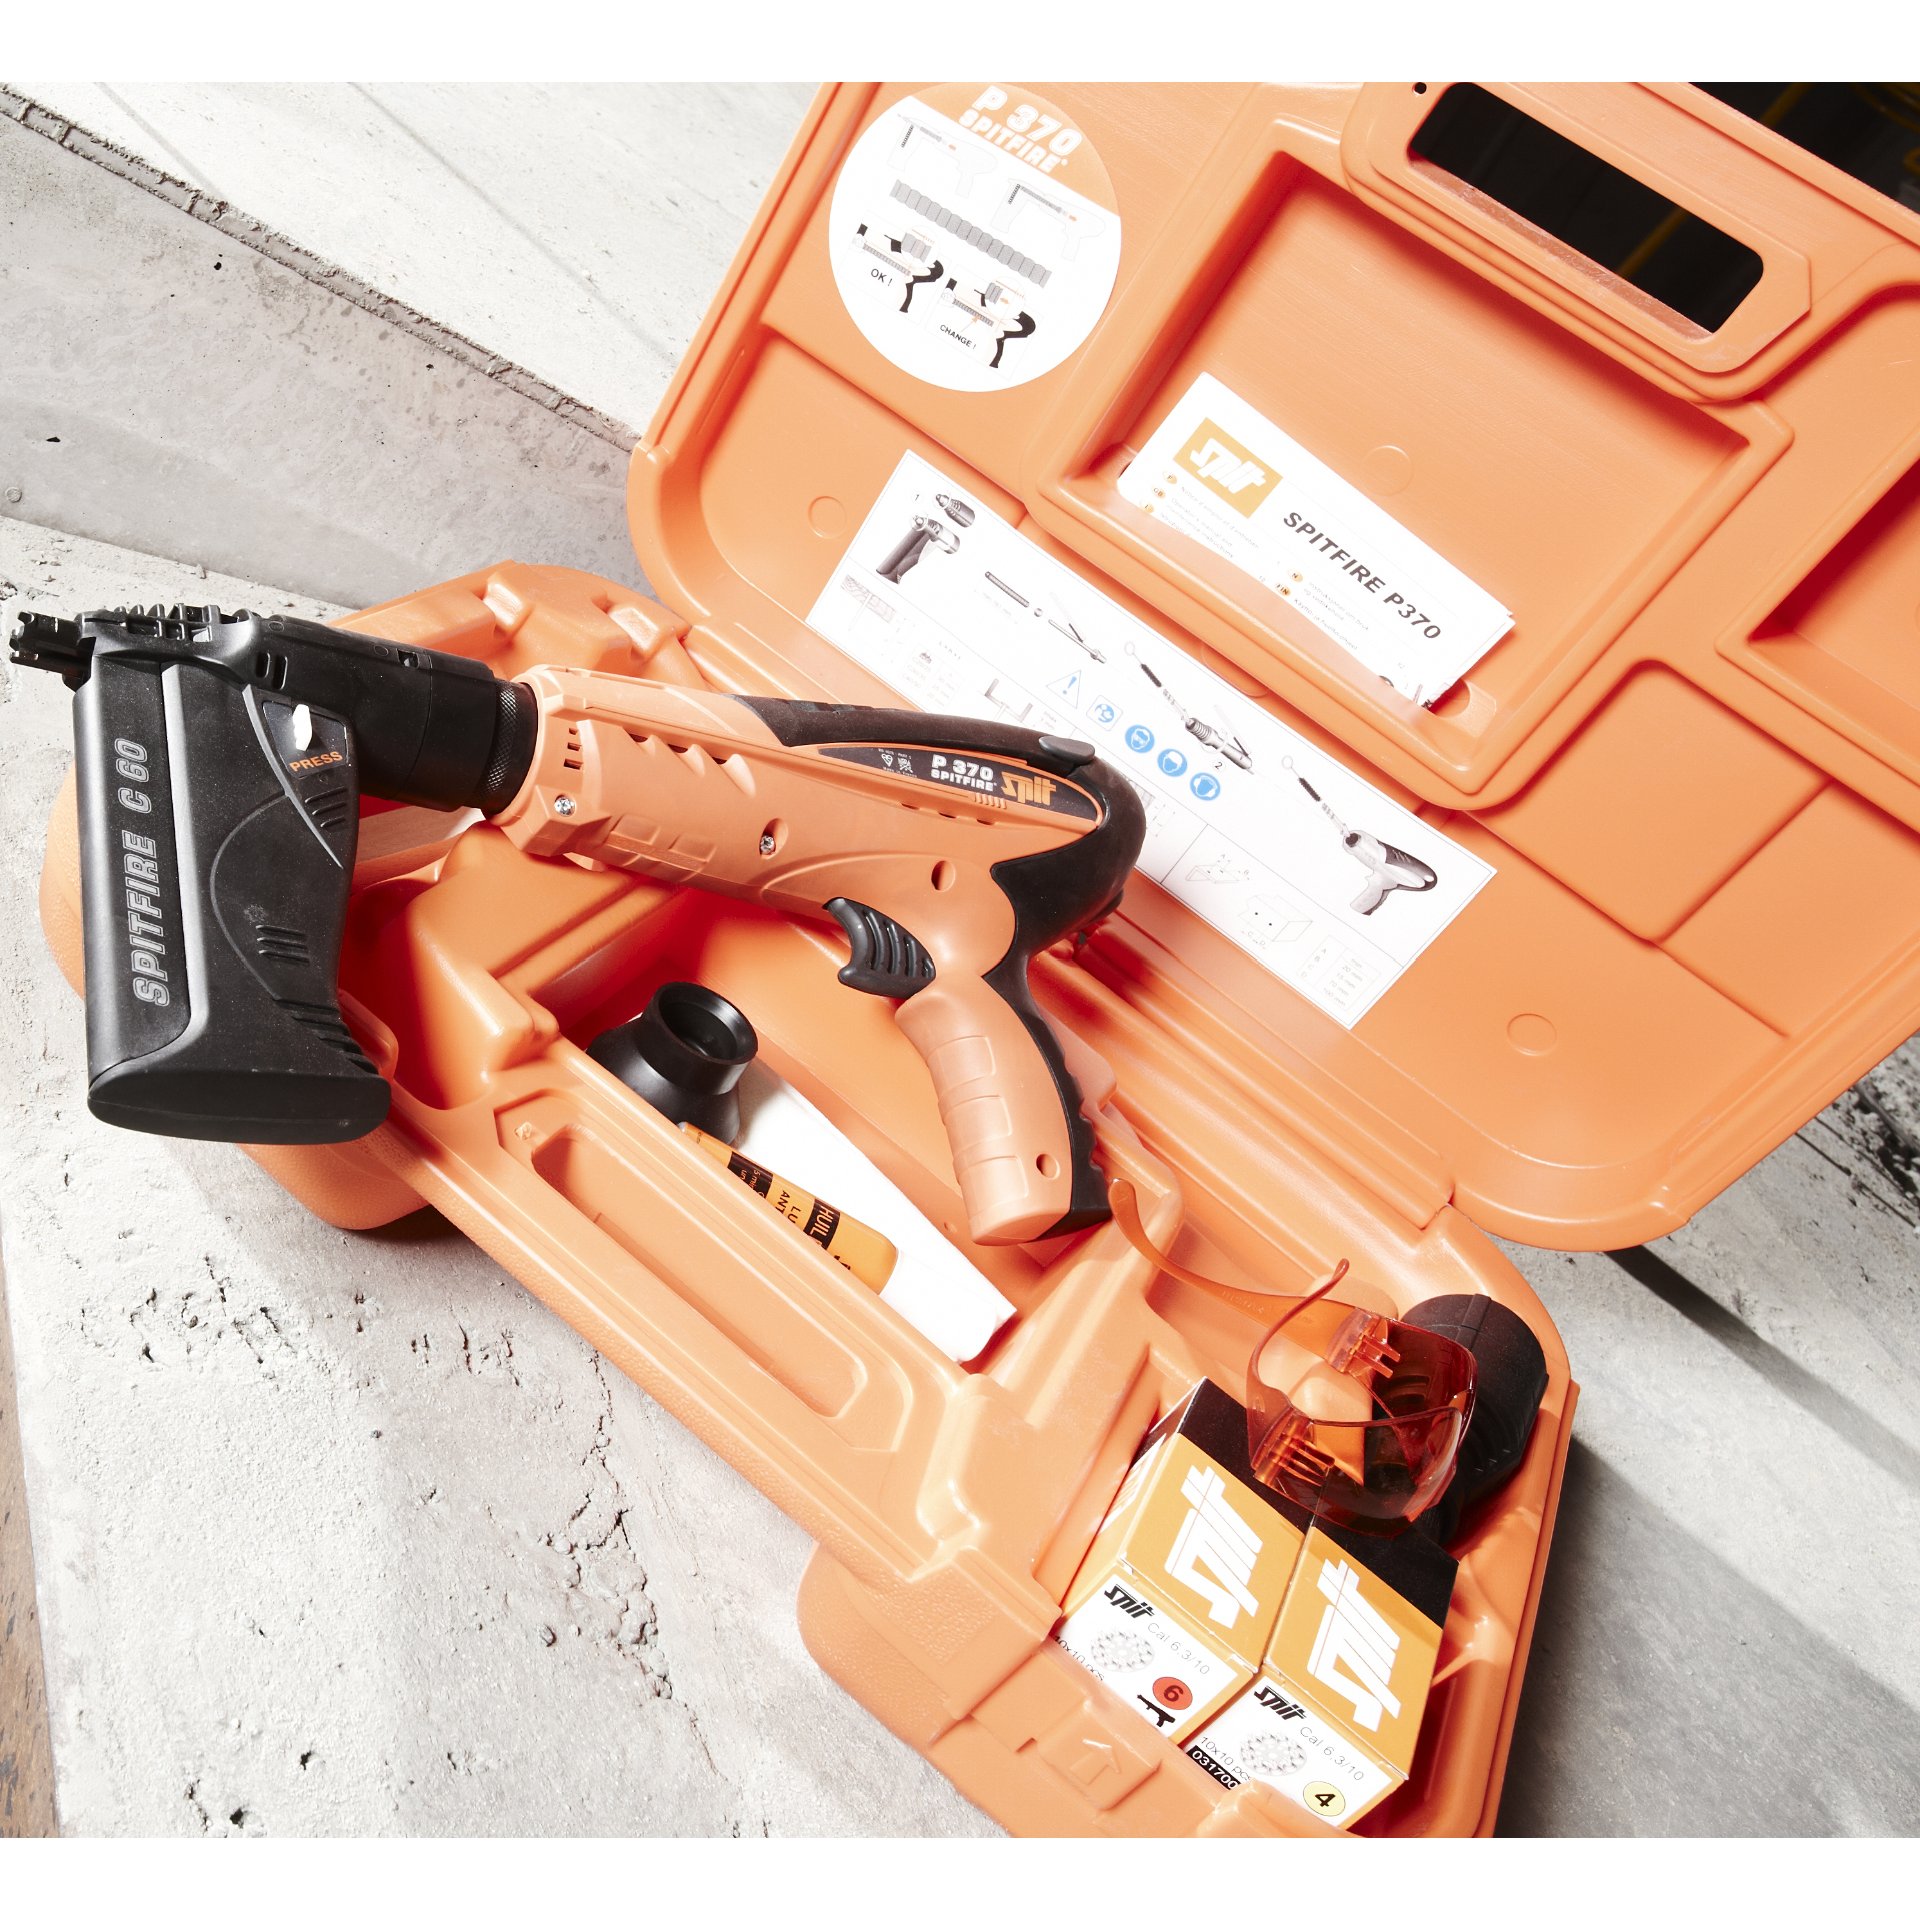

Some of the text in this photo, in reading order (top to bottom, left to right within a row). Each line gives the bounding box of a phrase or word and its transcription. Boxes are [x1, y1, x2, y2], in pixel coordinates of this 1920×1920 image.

[971, 85, 1083, 157] P 370
[939, 324, 972, 348] CHANGE
[1276, 583, 1290, 595] FIN
[1283, 512, 1441, 639] SPITFIRE P370
[289, 750, 343, 773] PRESS
[931, 754, 994, 781] P 370
[1214, 760, 1224, 770] 2
[930, 769, 994, 792] SPITFIRE
[113, 737, 170, 1007] SPITFIRE C 60
[1104, 1583, 1155, 1619] spit
[1147, 1622, 1210, 1675] Cal 6.3/10
[1163, 1684, 1184, 1702] 6
[1253, 1685, 1307, 1721] spit
[1200, 1736, 1234, 1766] 10x10
[1300, 1726, 1365, 1781] Cal 6.3/10
[1192, 1750, 1239, 1789] 031700
[1314, 1793, 1336, 1807] 4
